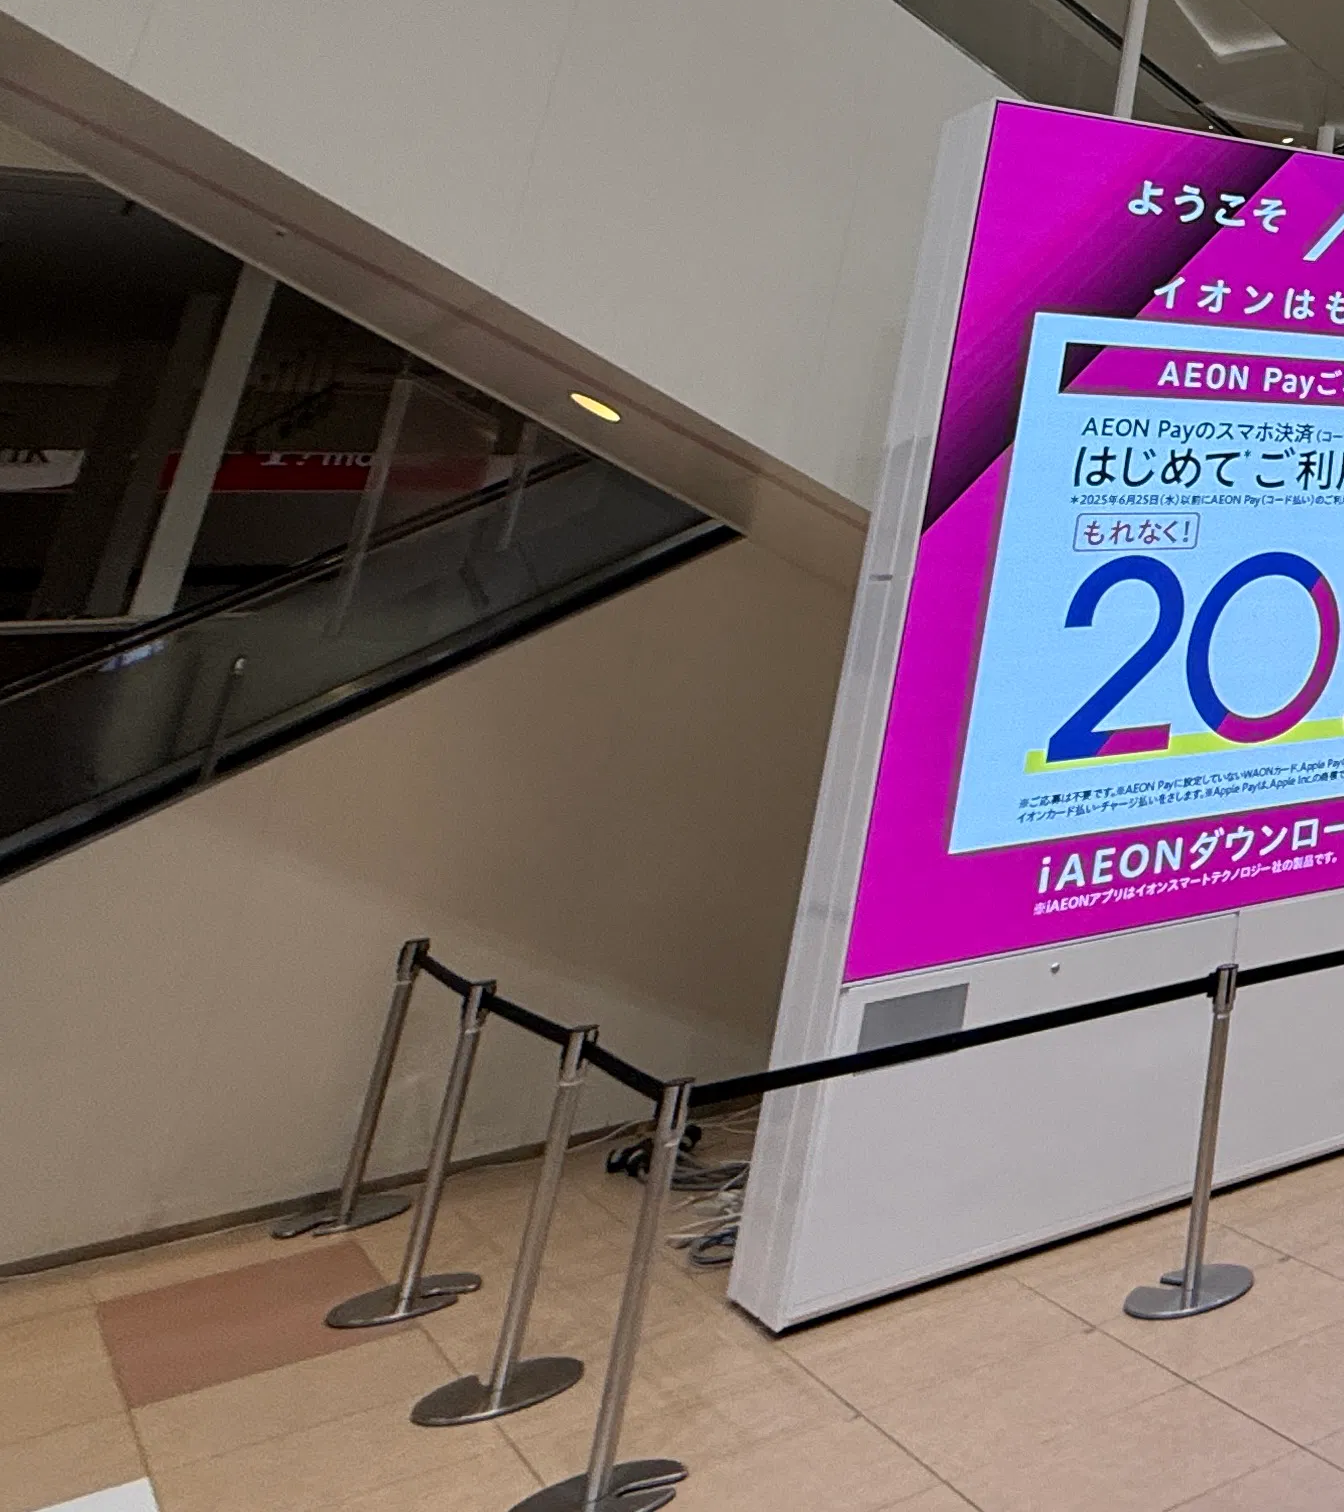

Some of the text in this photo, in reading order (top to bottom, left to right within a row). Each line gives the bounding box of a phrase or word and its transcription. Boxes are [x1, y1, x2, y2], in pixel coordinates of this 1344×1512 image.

[1127, 180, 1288, 234] ようこそ
[1157, 361, 1250, 391] AEON
[1081, 417, 1150, 438] AEON
[1084, 519, 1191, 546] もれなく!
